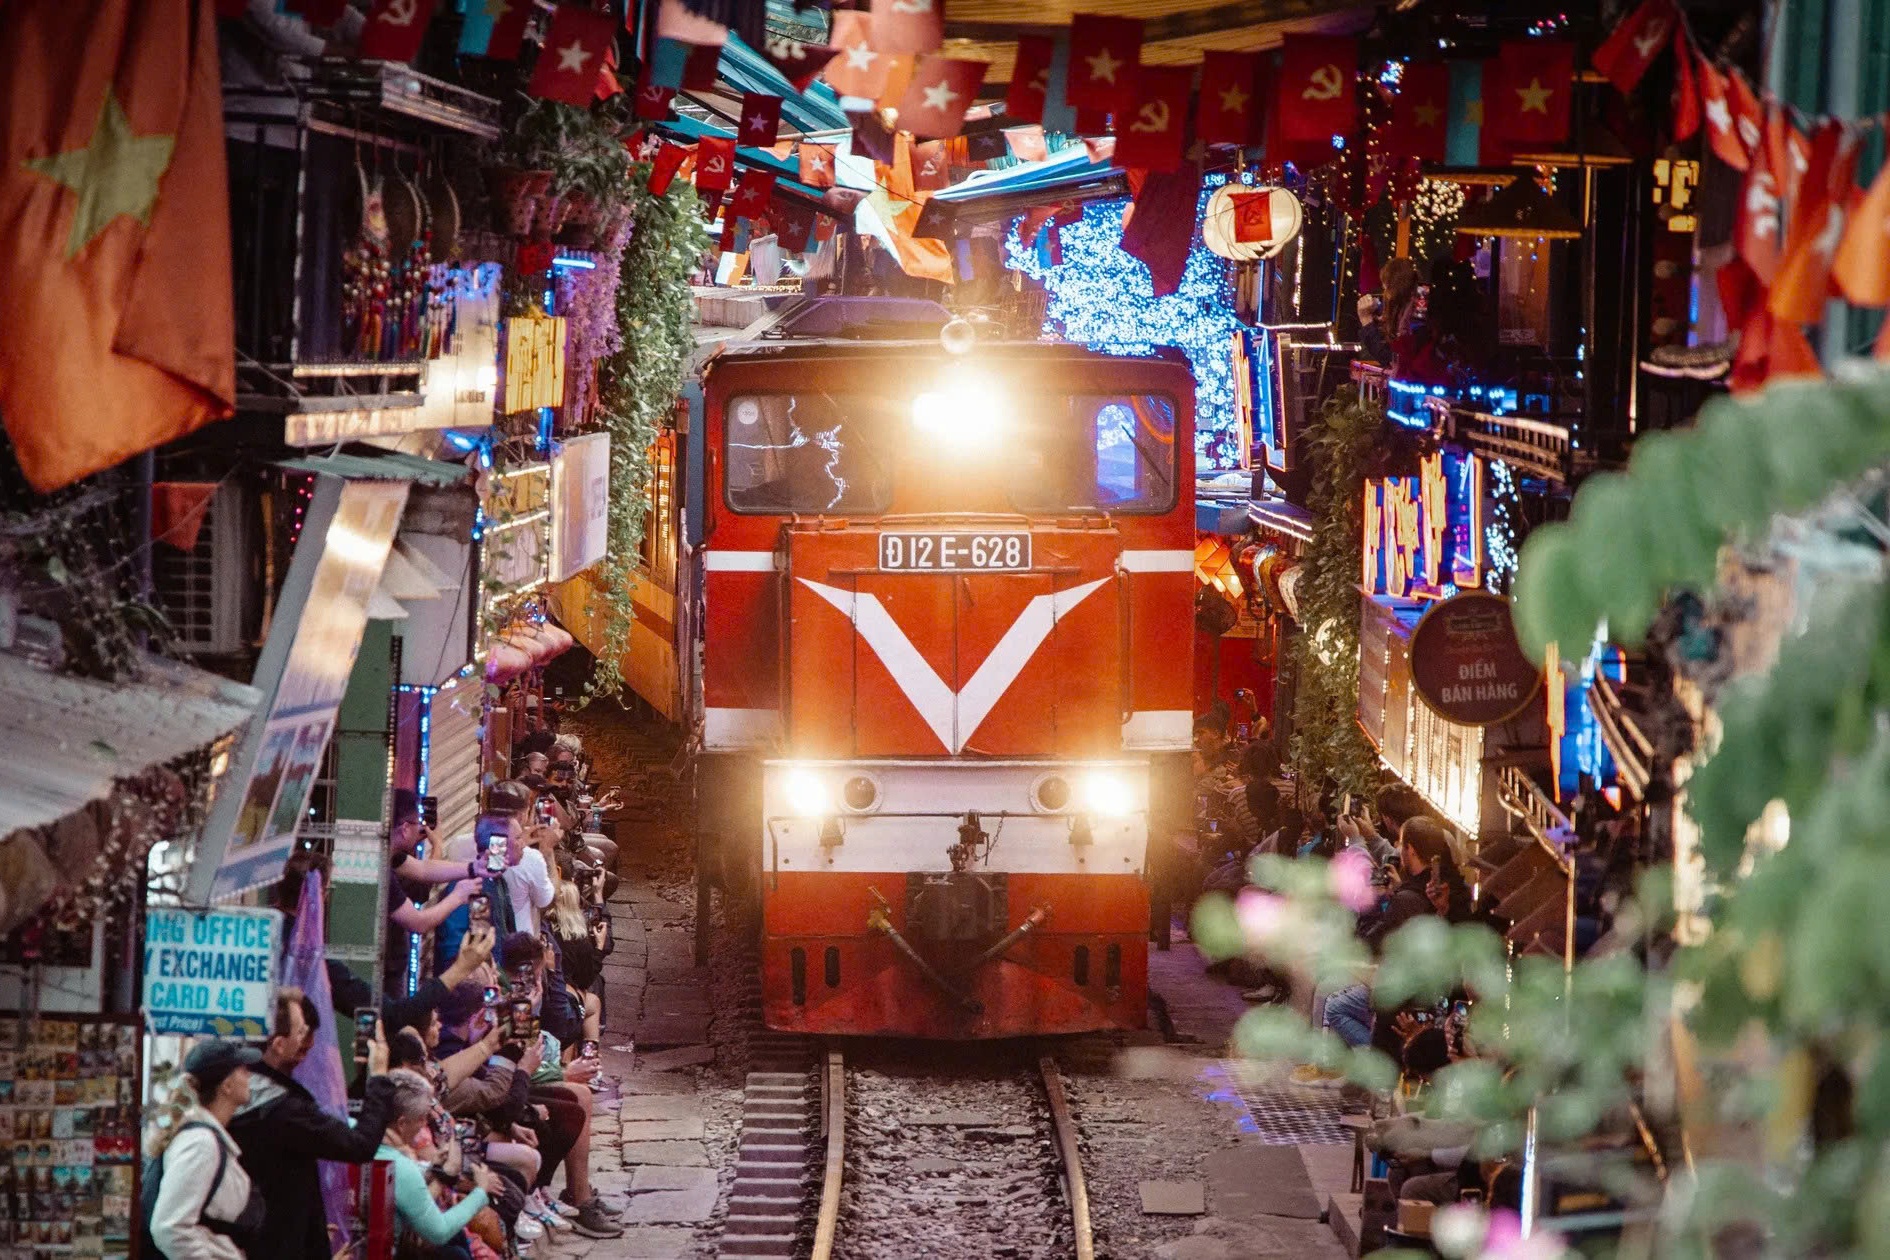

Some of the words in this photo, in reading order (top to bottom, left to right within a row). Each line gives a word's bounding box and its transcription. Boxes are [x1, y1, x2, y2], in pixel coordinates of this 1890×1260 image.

[1442, 684, 1472, 703] BÁN
[1476, 682, 1518, 700] HÀNG
[193, 915, 271, 949] OFFICE
[159, 949, 269, 982] EXCHANGE
[151, 982, 210, 1010] CARD
[217, 986, 245, 1013] 4G
